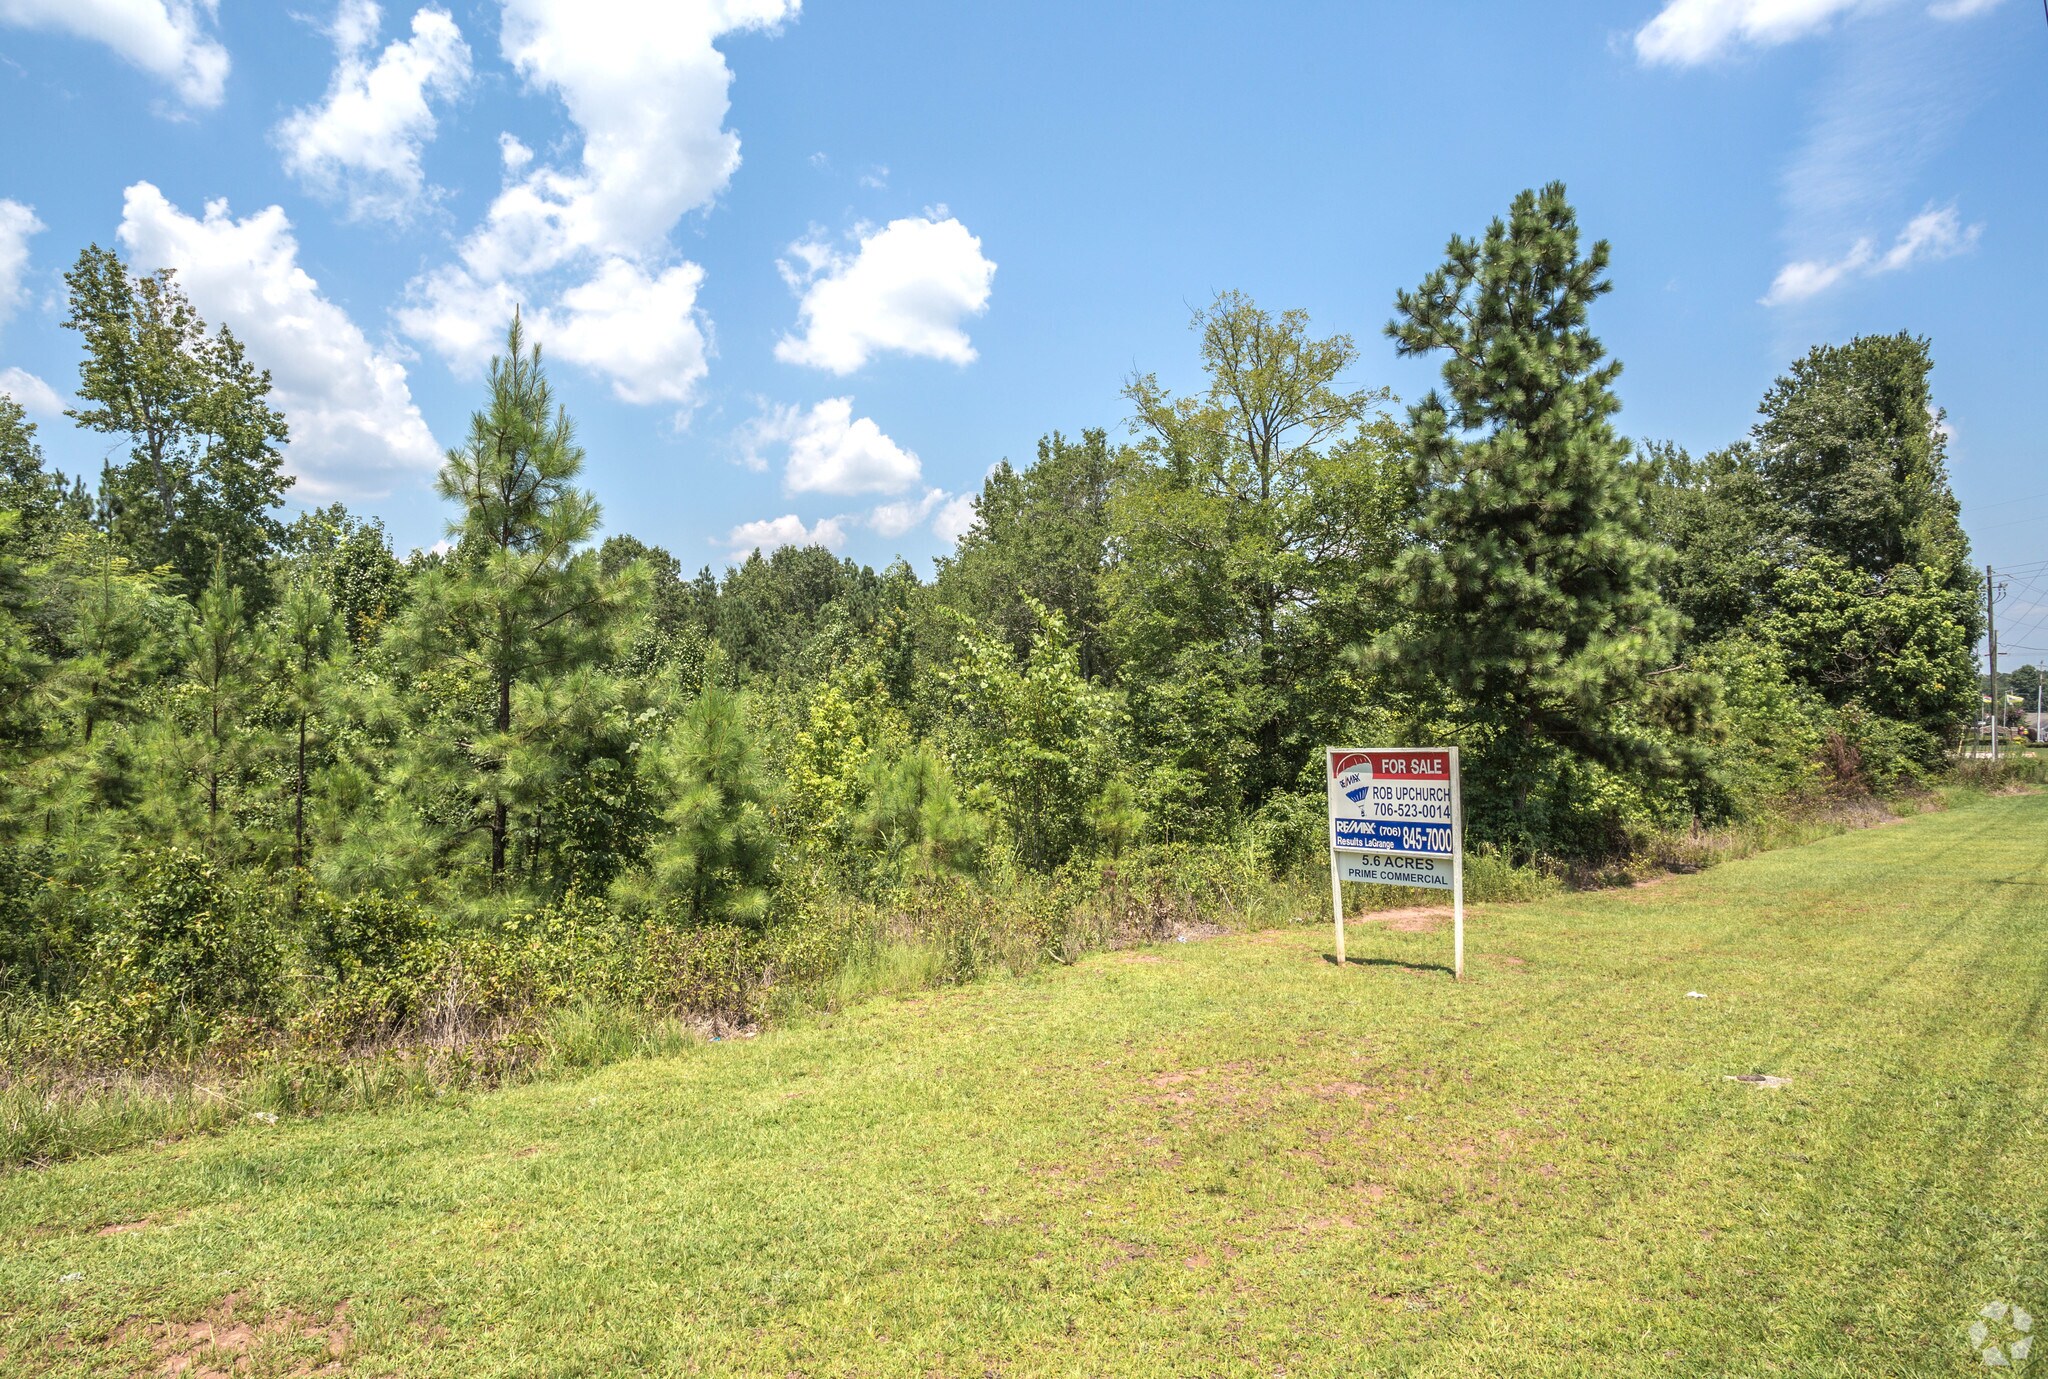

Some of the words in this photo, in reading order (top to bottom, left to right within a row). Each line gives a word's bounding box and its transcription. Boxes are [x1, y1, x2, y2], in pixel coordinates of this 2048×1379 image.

[1381, 759, 1406, 774] FOR
[1410, 759, 1443, 775] SALE
[1339, 773, 1361, 789] RE/MAX
[1372, 786, 1393, 800] ROB
[1396, 787, 1450, 802] UPCHURCH
[1373, 803, 1451, 819] 706-523-0014
[1336, 820, 1376, 835] RE/MAX
[1379, 825, 1401, 837] (706)
[1402, 826, 1452, 852] 845-7000
[1337, 836, 1363, 847] Results
[1364, 838, 1395, 850] LaGrange
[1362, 855, 1380, 867] 5.6
[1384, 856, 1434, 871] ACRES
[1348, 868, 1377, 879] PRIME
[1380, 871, 1448, 885] COMMERCIAL
